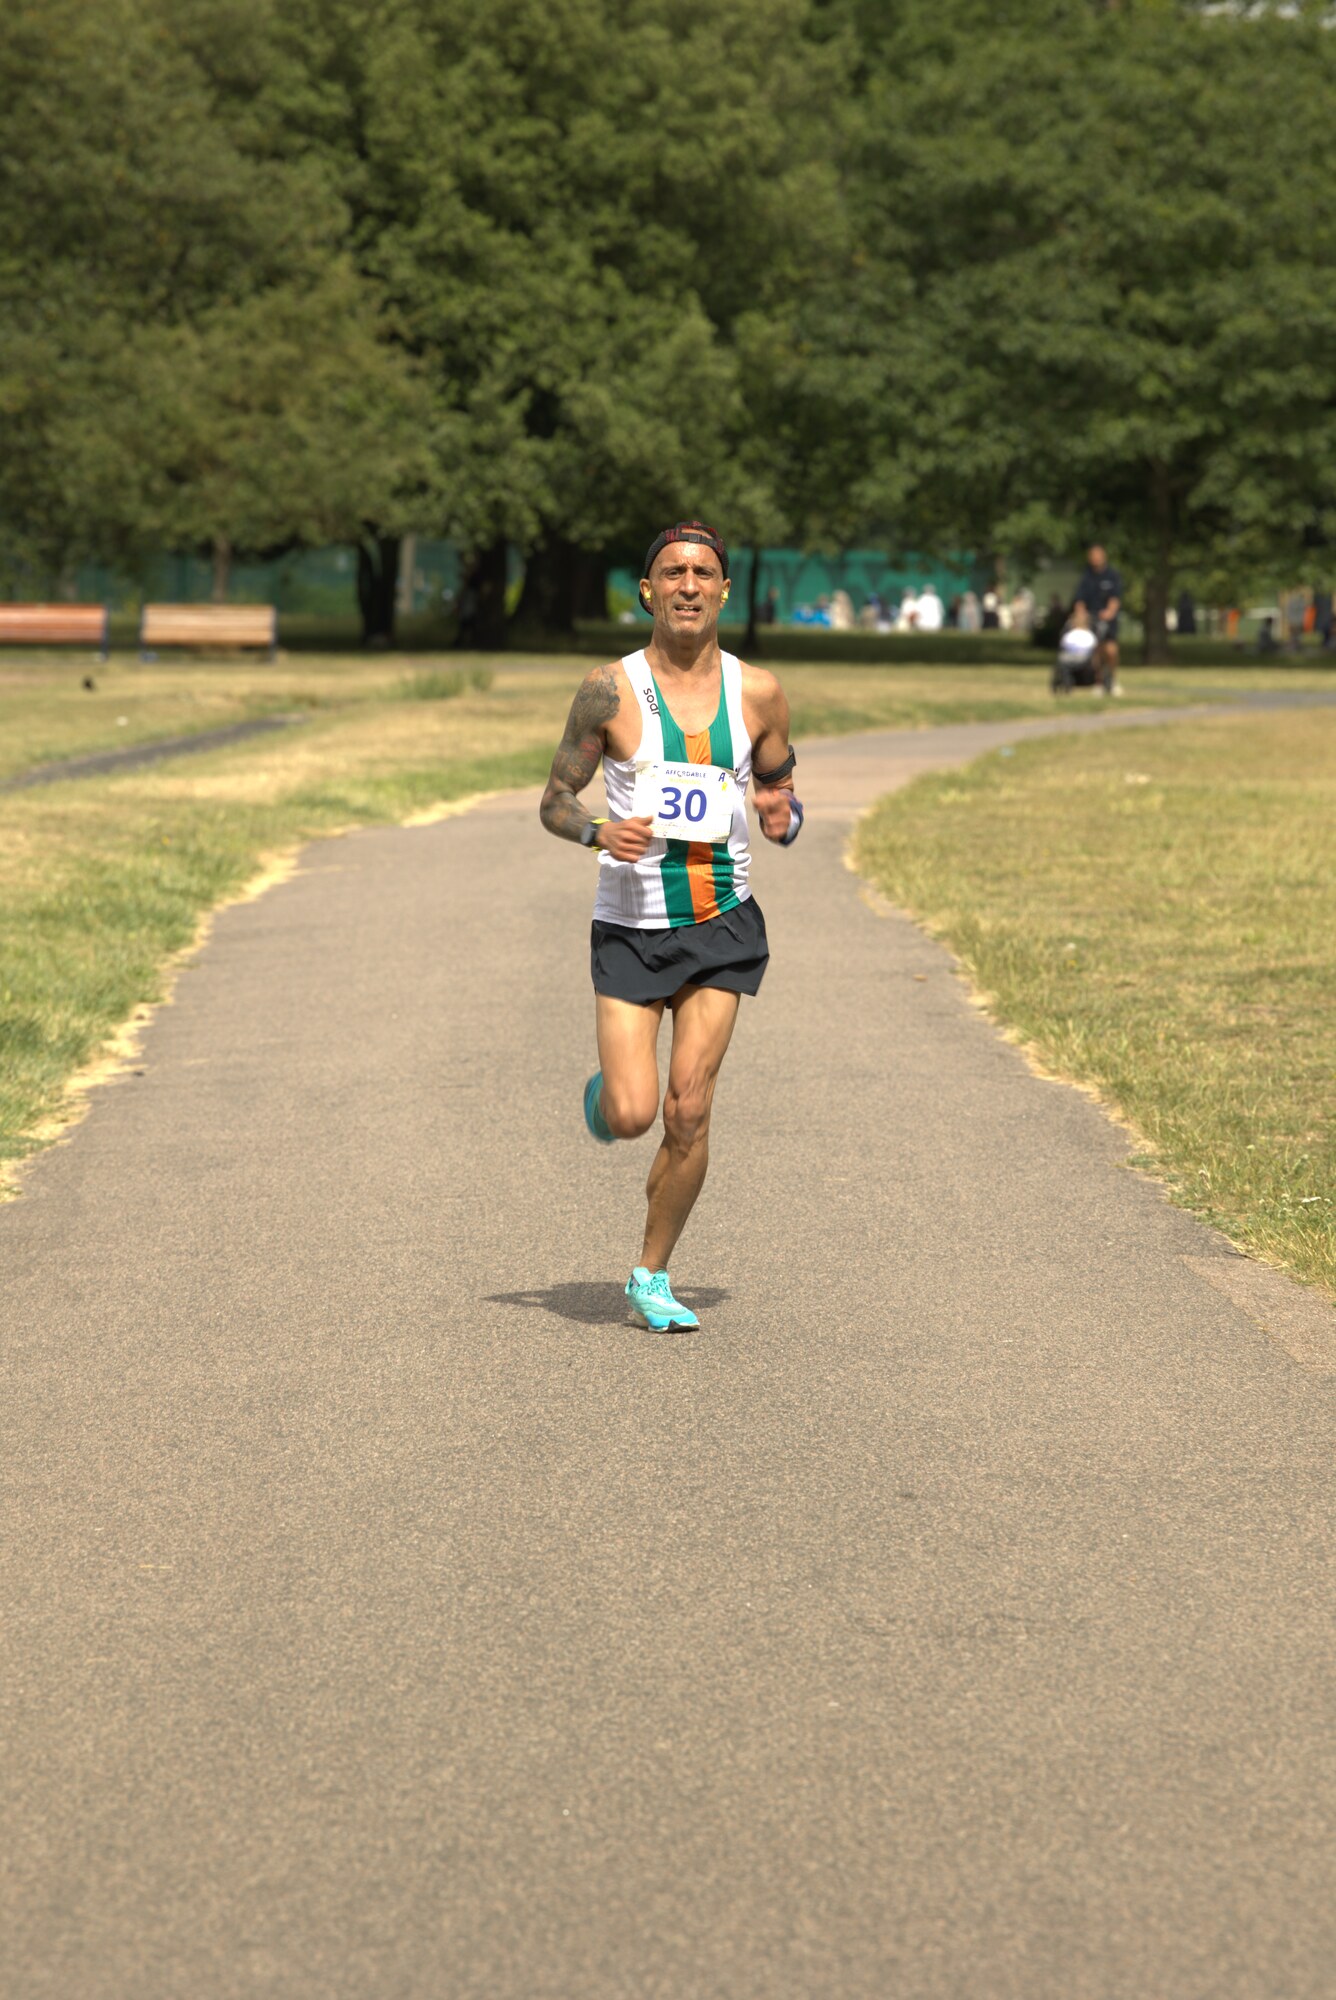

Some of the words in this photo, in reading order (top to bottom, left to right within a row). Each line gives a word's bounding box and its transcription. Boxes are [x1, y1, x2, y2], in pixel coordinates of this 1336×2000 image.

[643, 688, 661, 717] soar
[718, 772, 726, 782] A
[658, 786, 707, 822] 30
